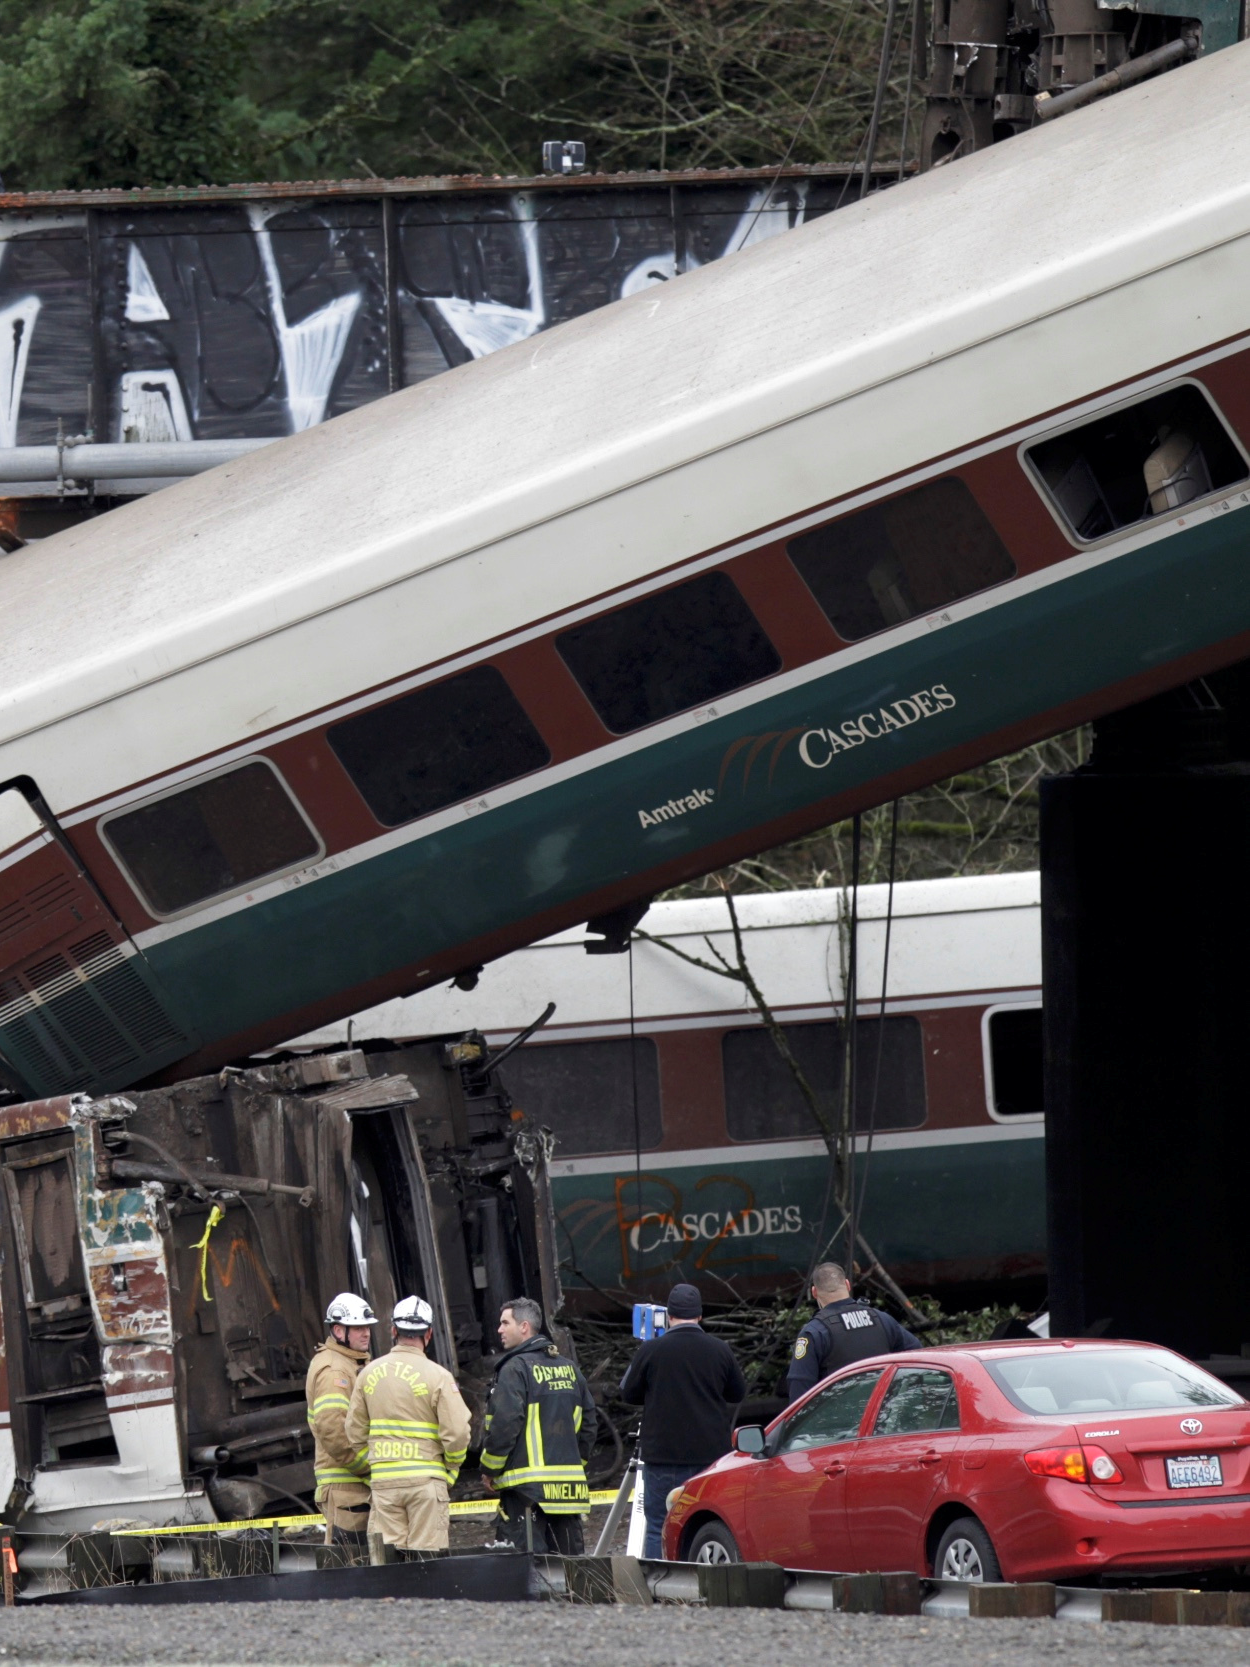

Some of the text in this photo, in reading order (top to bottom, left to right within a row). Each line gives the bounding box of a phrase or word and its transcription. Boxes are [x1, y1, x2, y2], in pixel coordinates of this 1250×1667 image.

[798, 684, 957, 769] CASCADES
[630, 1205, 802, 1253] CASCADES
[841, 1310, 873, 1330] POLICE
[363, 1361, 429, 1397] SORT TEAM
[548, 1380, 575, 1391] FIRE
[1085, 1430, 1120, 1438] COROLLA
[374, 1441, 424, 1459] SOBOL
[1171, 1465, 1219, 1484] AEE6492
